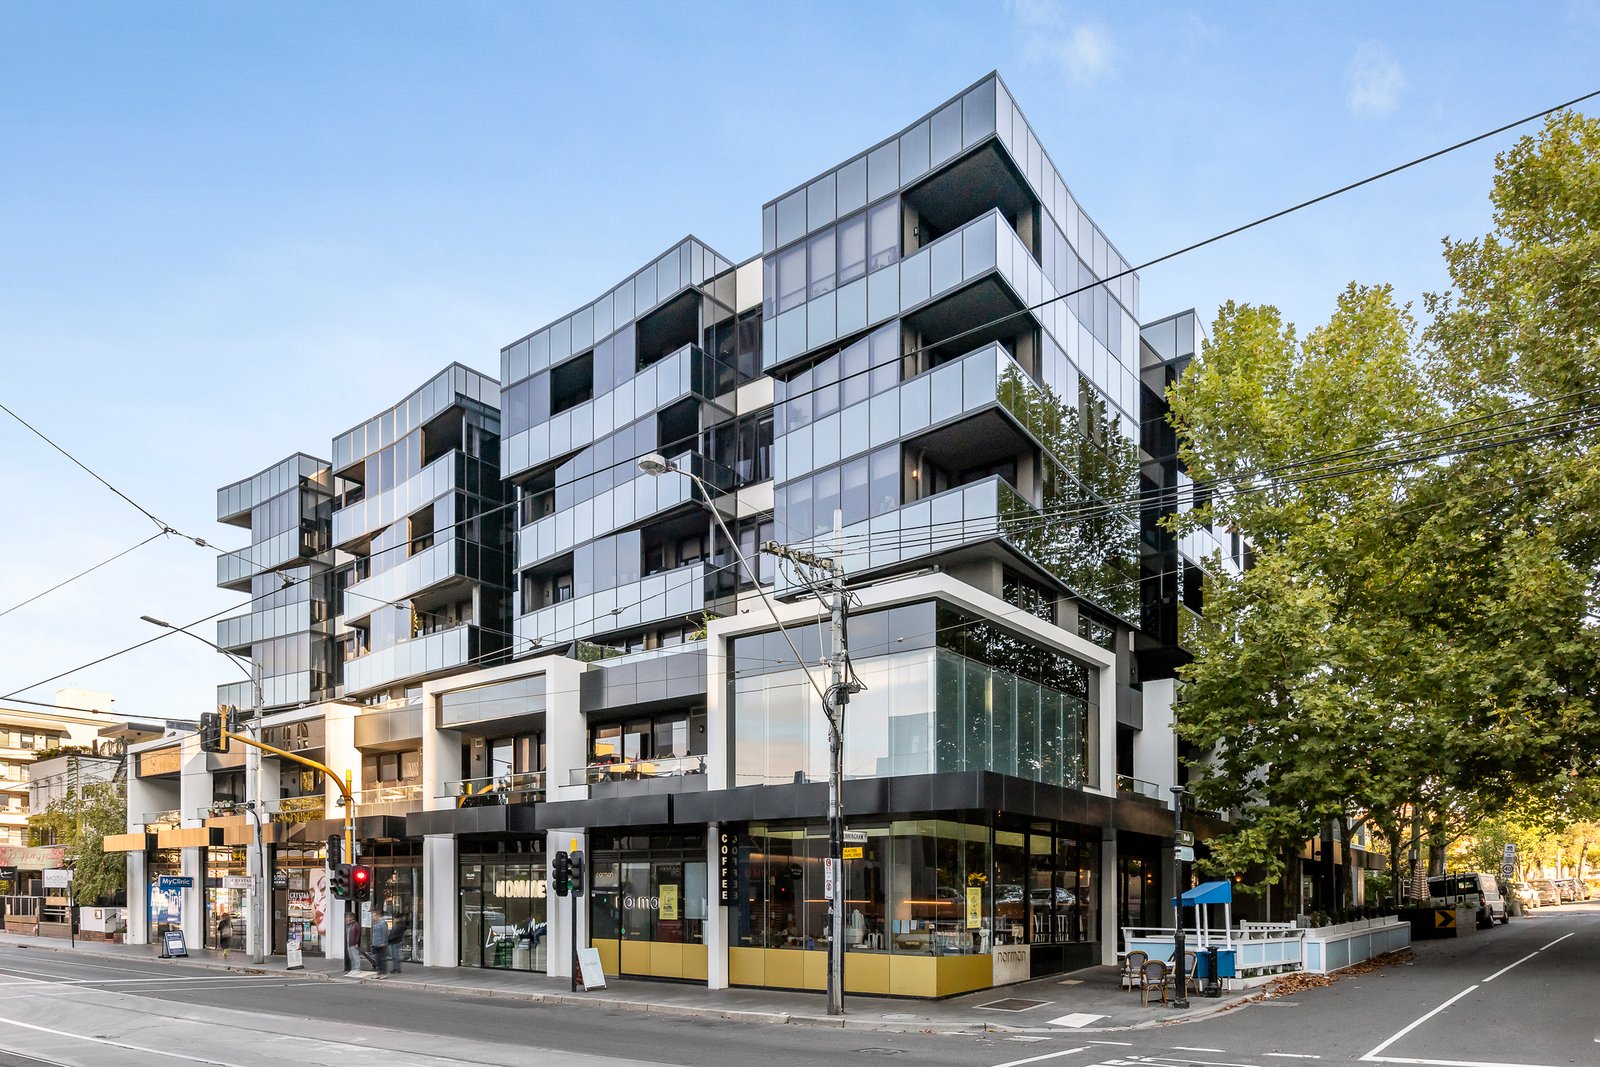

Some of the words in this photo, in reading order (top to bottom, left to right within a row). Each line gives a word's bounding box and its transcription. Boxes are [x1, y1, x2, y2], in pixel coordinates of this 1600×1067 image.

[162, 878, 190, 886] MyClinic
[496, 880, 548, 898] HOMME
[615, 896, 660, 910] norma
[485, 928, 506, 948] Love
[997, 950, 1027, 963] norman
